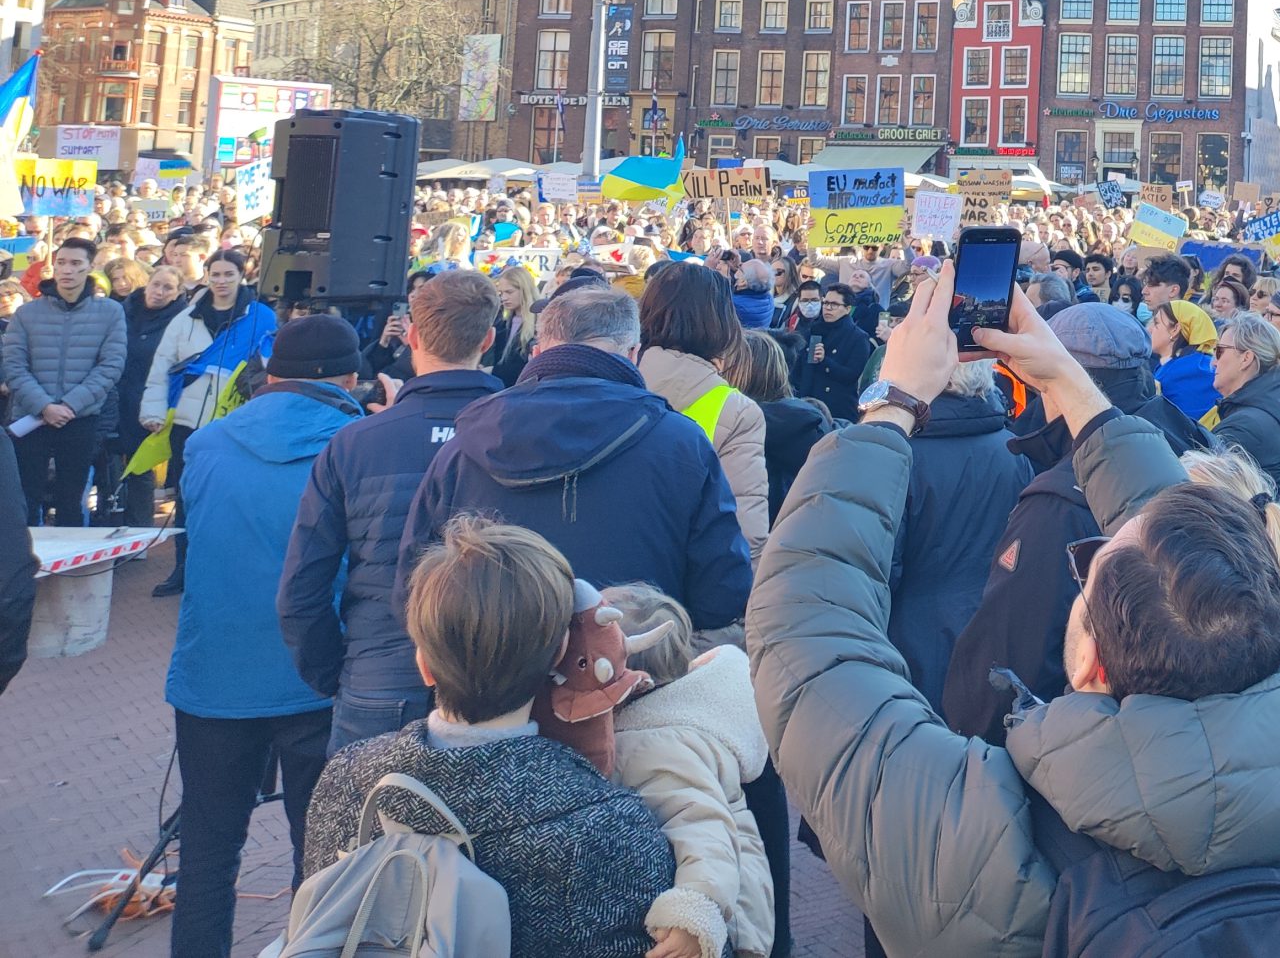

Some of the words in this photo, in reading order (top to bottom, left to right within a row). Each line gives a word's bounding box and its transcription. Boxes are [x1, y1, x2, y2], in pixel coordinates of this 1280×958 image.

[579, 97, 630, 106] DLEN
[1099, 101, 1138, 119] Drie
[1145, 102, 1221, 124] Gezusters
[63, 127, 94, 140] STOP
[878, 129, 915, 140] GROOTE
[915, 129, 942, 140] GRIET
[61, 145, 102, 156] SUPPORT
[20, 175, 46, 200] NO
[51, 177, 88, 199] WAR
[826, 175, 847, 192] EU
[965, 196, 988, 209] NO
[825, 213, 883, 235] Concern
